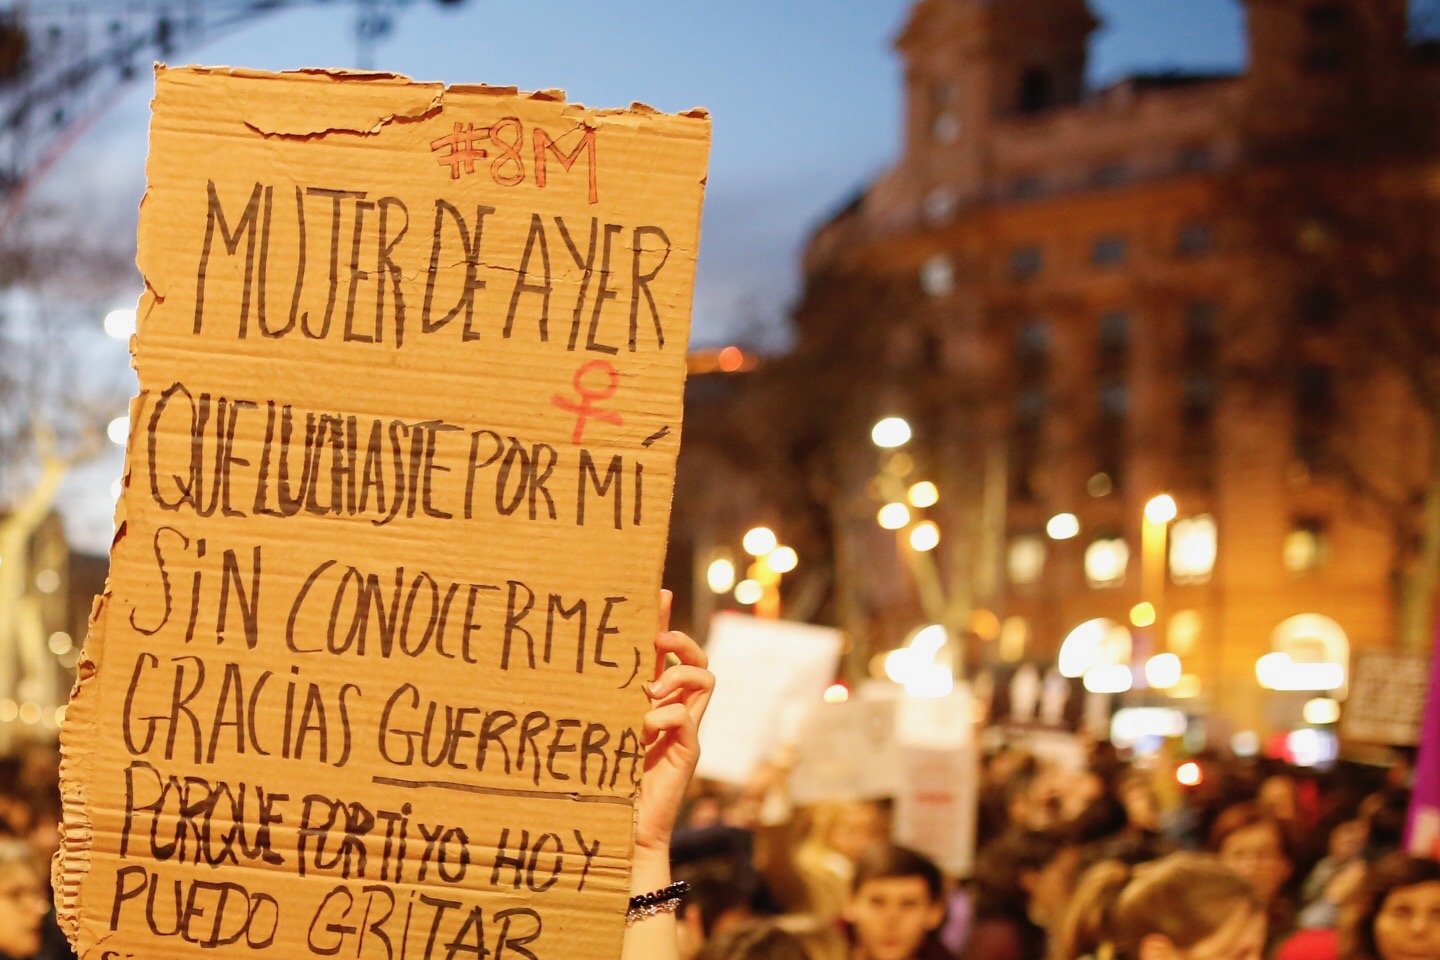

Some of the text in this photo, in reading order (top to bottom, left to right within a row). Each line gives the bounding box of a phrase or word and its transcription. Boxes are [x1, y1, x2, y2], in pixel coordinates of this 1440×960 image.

[429, 115, 599, 205] #8M
[193, 180, 672, 355] MUJER DE AYER
[146, 381, 672, 530] QUE LUCHASTE POR MÍ
[285, 558, 641, 690] CONOCERME,
[377, 681, 644, 792] GUERRERA
[119, 760, 290, 870] PORQUE
[296, 793, 375, 880] POR
[417, 822, 471, 885] YO
[489, 827, 602, 893] HOY
[109, 865, 279, 951] PUEDO
